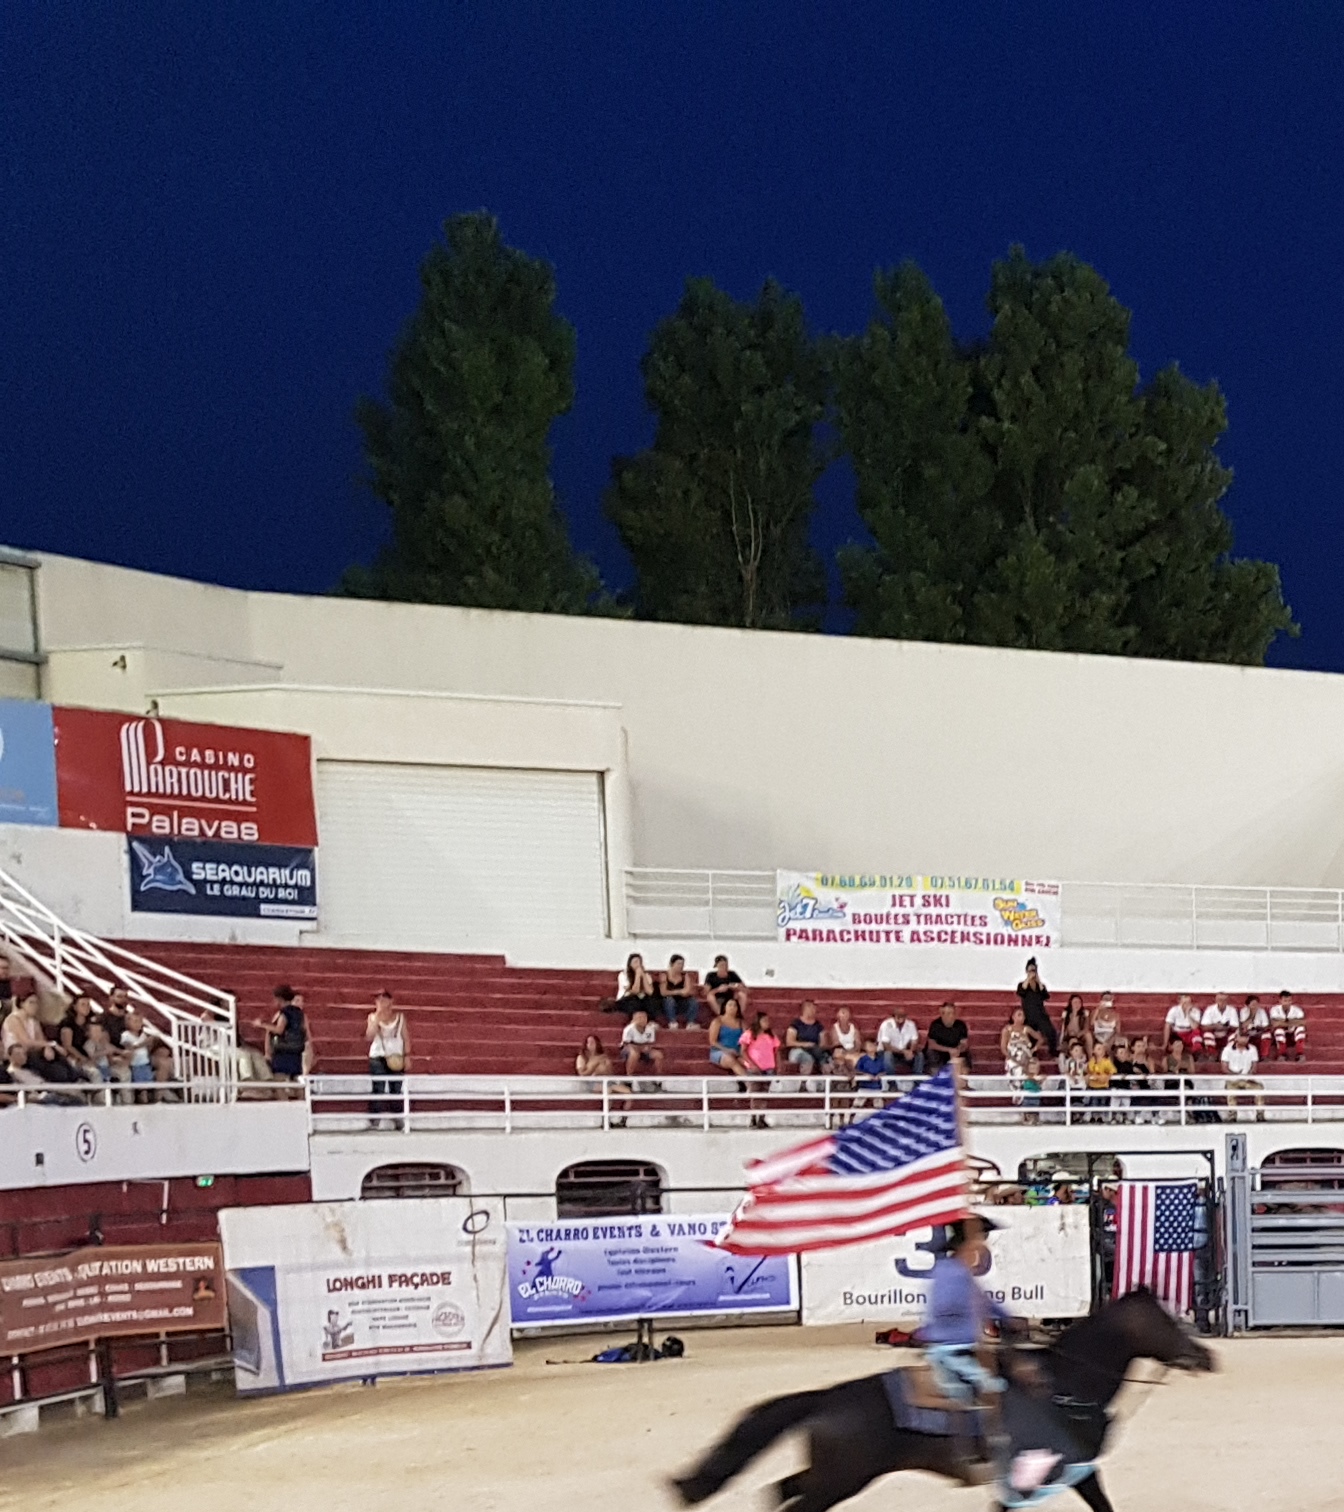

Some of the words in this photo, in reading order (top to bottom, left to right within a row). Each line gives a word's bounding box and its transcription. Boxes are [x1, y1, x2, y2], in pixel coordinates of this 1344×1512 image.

[175, 746, 255, 768] CASINO
[126, 806, 259, 841] Palavas
[191, 862, 312, 887] SEAQUARIUM
[206, 884, 222, 896] LE
[224, 885, 255, 898] GRAU
[258, 887, 275, 899] DU
[278, 888, 299, 900] ROI
[891, 894, 917, 908] JET
[921, 894, 950, 908] SKI
[785, 927, 905, 943] PARACHUTE
[536, 1227, 589, 1241] CHARRO
[592, 1224, 643, 1240] EVENTS
[650, 1224, 661, 1237] &
[667, 1222, 707, 1236] VANO
[146, 1256, 215, 1271] WESTERN
[326, 1274, 382, 1293] LONGHI
[388, 1271, 452, 1290] FAÇADE
[842, 1289, 927, 1306] Bourillon
[1012, 1285, 1044, 1301] Bull
